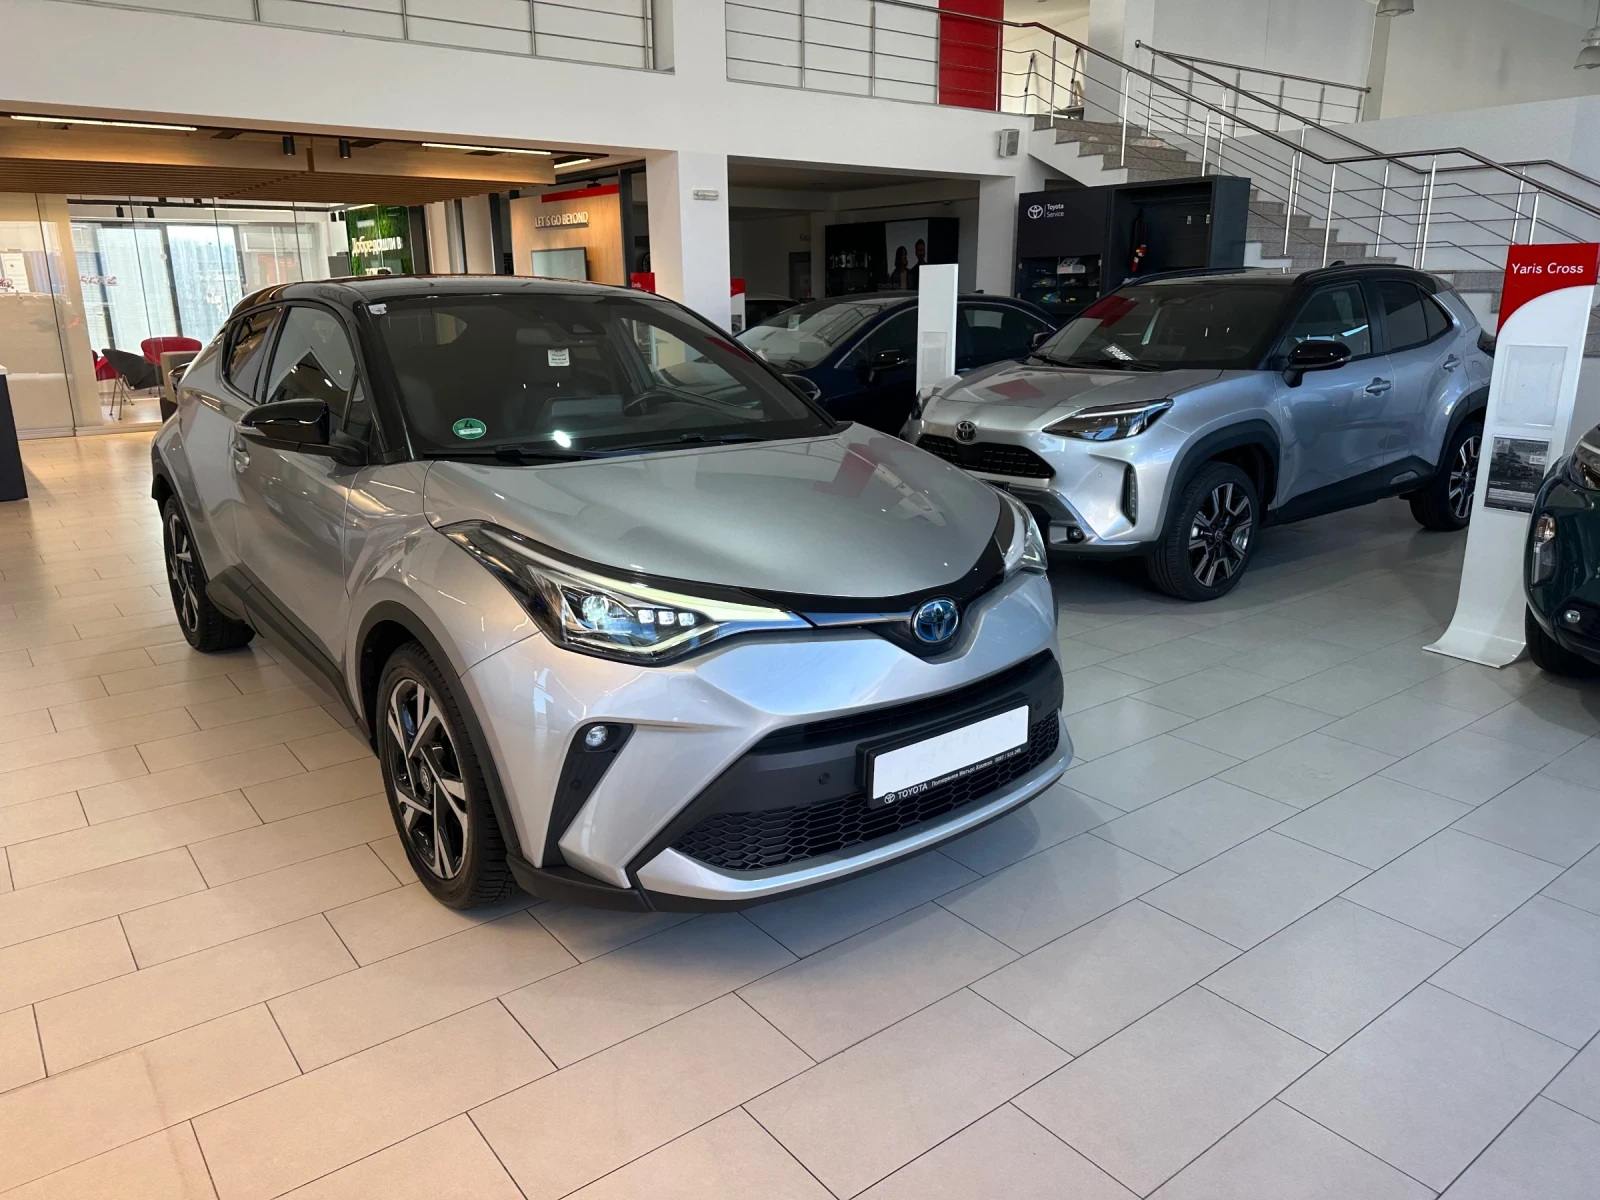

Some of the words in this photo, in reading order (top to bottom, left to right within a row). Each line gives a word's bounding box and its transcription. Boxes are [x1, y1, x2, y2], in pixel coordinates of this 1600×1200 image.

[1047, 203, 1064, 211] Toyota
[551, 214, 562, 226] GO
[562, 211, 589, 225] BEYOND
[1512, 263, 1543, 274] Yaris
[1547, 262, 1584, 274] Cross
[897, 783, 928, 800] TOYOTA
